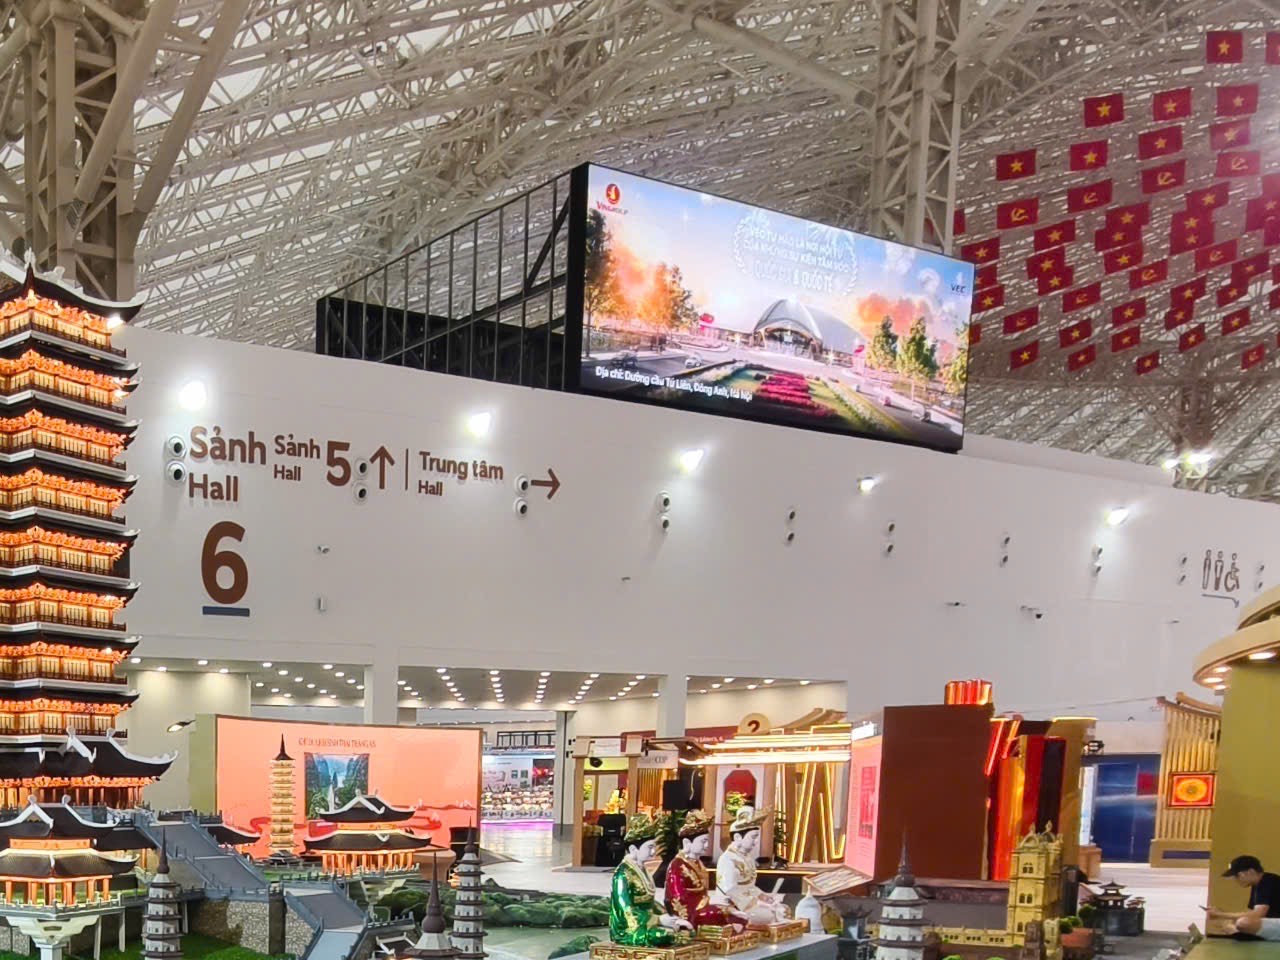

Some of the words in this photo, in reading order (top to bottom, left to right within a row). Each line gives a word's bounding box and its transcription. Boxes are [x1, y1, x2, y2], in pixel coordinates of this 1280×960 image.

[190, 425, 267, 465] Sảnh
[274, 434, 320, 459] Sảnh
[273, 464, 302, 482] Hall
[326, 440, 351, 487] 5
[419, 450, 469, 481] Trung
[472, 458, 504, 481] tâm
[189, 473, 239, 502] Hall
[418, 480, 443, 497] Hall
[201, 520, 249, 605] 6
